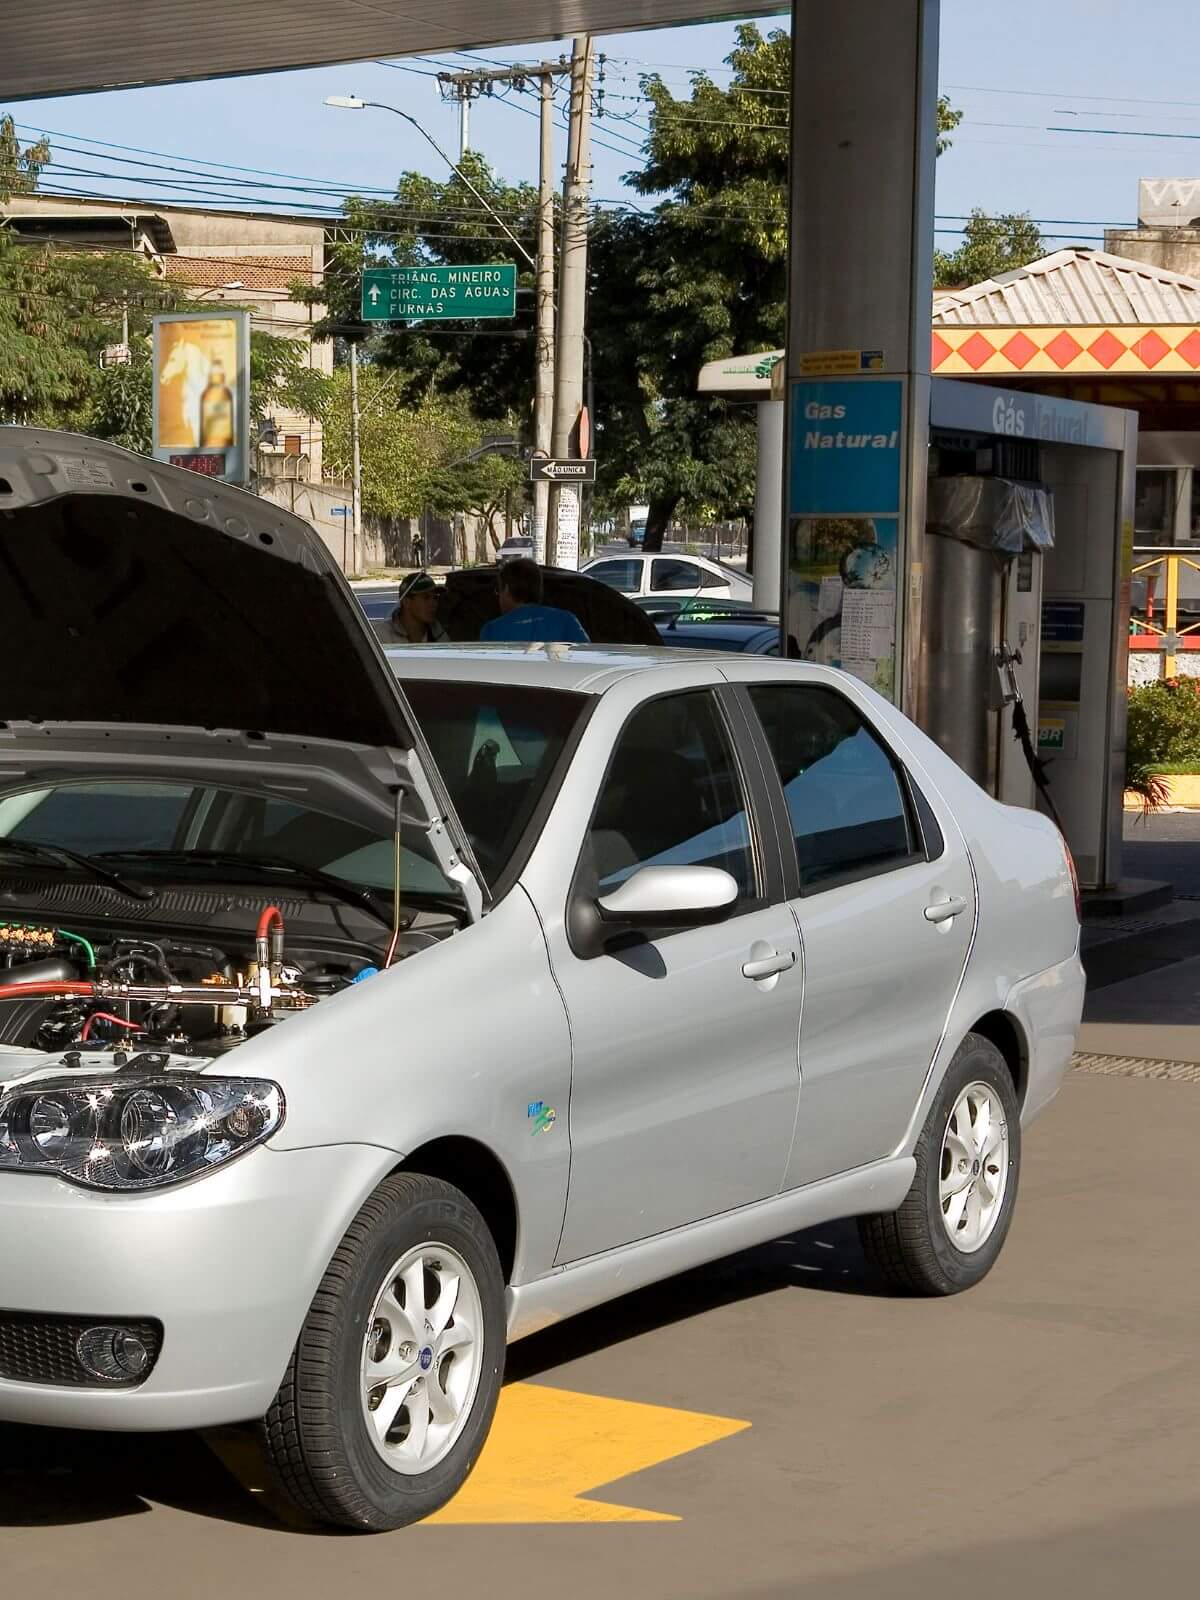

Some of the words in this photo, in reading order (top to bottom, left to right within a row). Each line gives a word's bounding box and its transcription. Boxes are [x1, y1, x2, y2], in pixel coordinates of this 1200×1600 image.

[390, 270, 441, 285] TRIÂNG.
[448, 271, 501, 283] MINEIRO
[390, 288, 422, 300] CIRC.
[431, 287, 456, 299] DAS
[390, 302, 444, 315] FURNAS
[804, 401, 846, 420] Gas
[992, 396, 1025, 437] Gás
[804, 430, 899, 449] Natural
